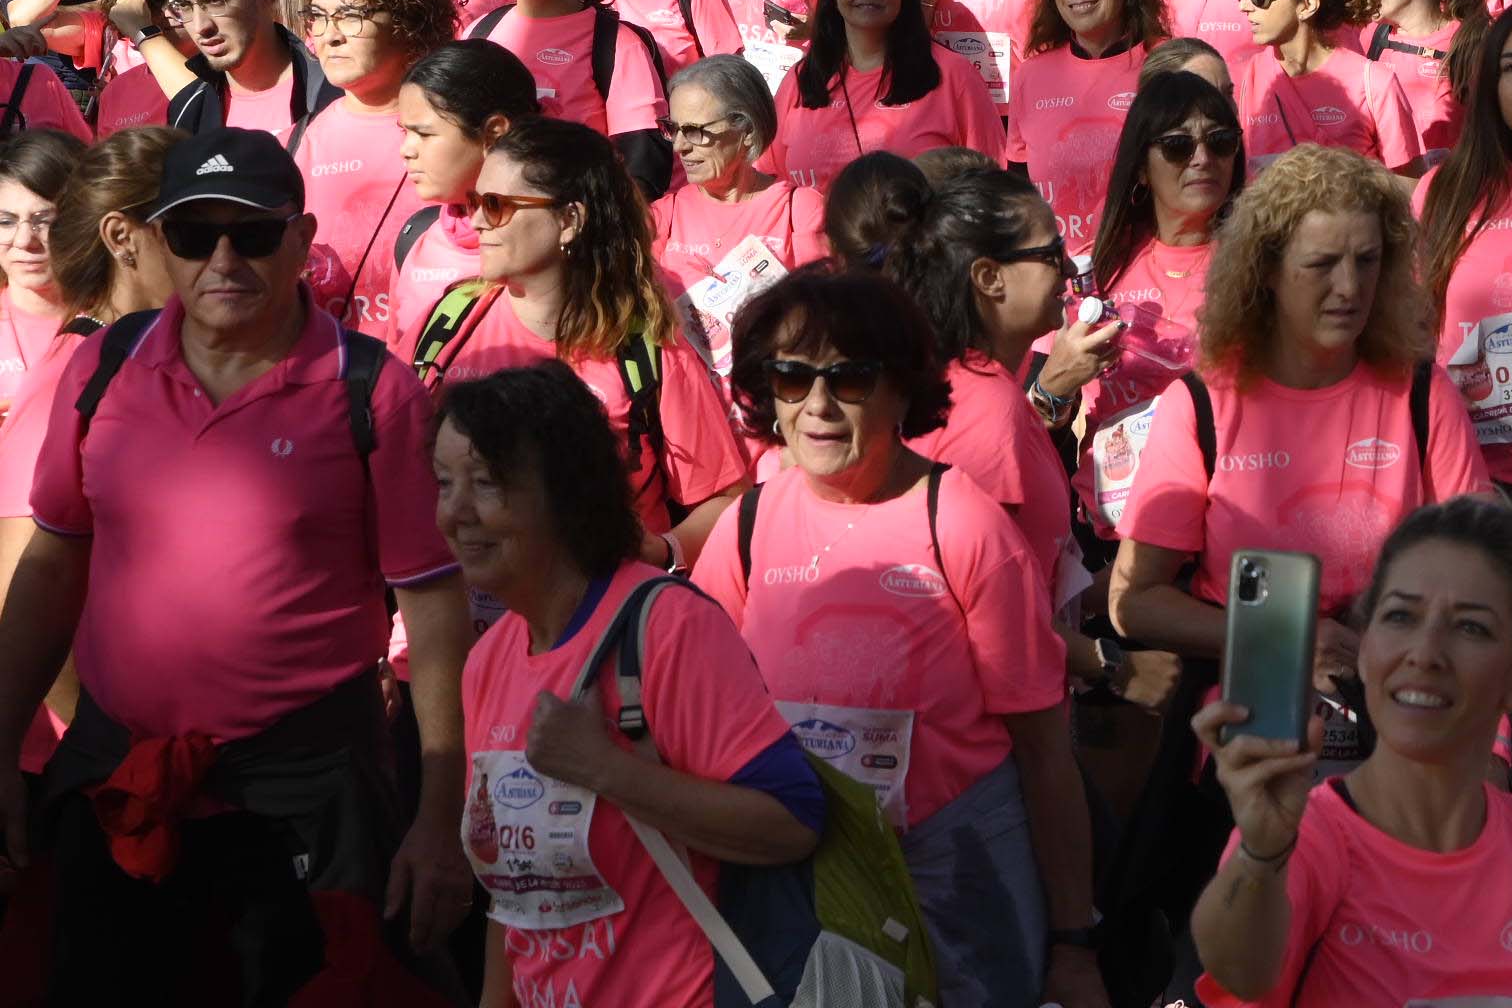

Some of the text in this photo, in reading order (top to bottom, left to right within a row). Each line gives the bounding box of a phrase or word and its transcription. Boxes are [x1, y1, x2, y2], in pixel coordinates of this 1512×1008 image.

[1199, 22, 1241, 33] OYSHO
[1035, 96, 1074, 110] OYSHO
[196, 165, 234, 176] adidas
[311, 159, 362, 177] OYSHO
[665, 241, 710, 256] OYSHO
[1220, 451, 1291, 472] OYSHO
[764, 566, 945, 592] OYSHO ASTURIANA
[862, 732, 899, 743] SUMA
[1340, 922, 1434, 954] OYSHO
